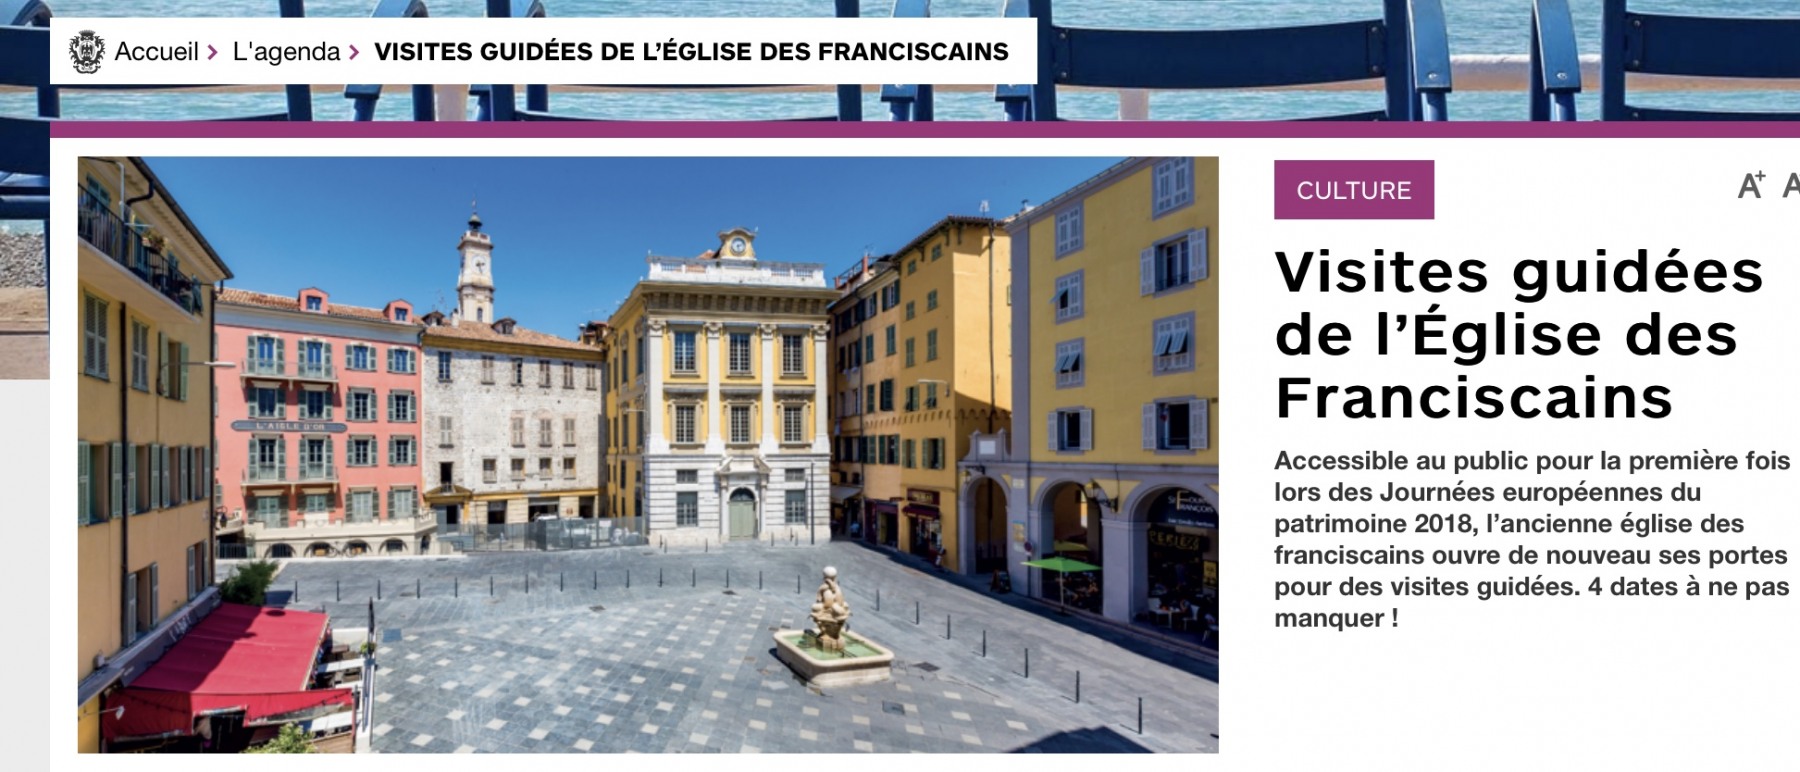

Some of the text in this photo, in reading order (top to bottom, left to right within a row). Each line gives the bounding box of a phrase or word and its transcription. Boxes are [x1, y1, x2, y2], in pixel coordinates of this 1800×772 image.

[114, 37, 1009, 67] Accueil L'agenda VISITES GUIDÉES DE L’ÉGLISE DES FRANCISCAINS
[1297, 181, 1412, 200] CULTURE
[1274, 247, 1763, 304] Visites guidées
[1276, 303, 1737, 367] de l’Église des
[1278, 374, 1672, 419] Franciscains
[256, 422, 299, 430] L'AIGLE
[1273, 448, 1791, 475] Accessible au public pour la première fois
[1275, 479, 1701, 506] lors des Journées européennes du
[1275, 511, 1745, 538] patrimoine 2018, l’ancienne église des
[1273, 544, 1788, 569] franciscains ouvre de nouveau ses portes
[1275, 574, 1790, 601] pour des visites guidées. 4 dates à ne pas
[1275, 612, 1385, 632] manquer
